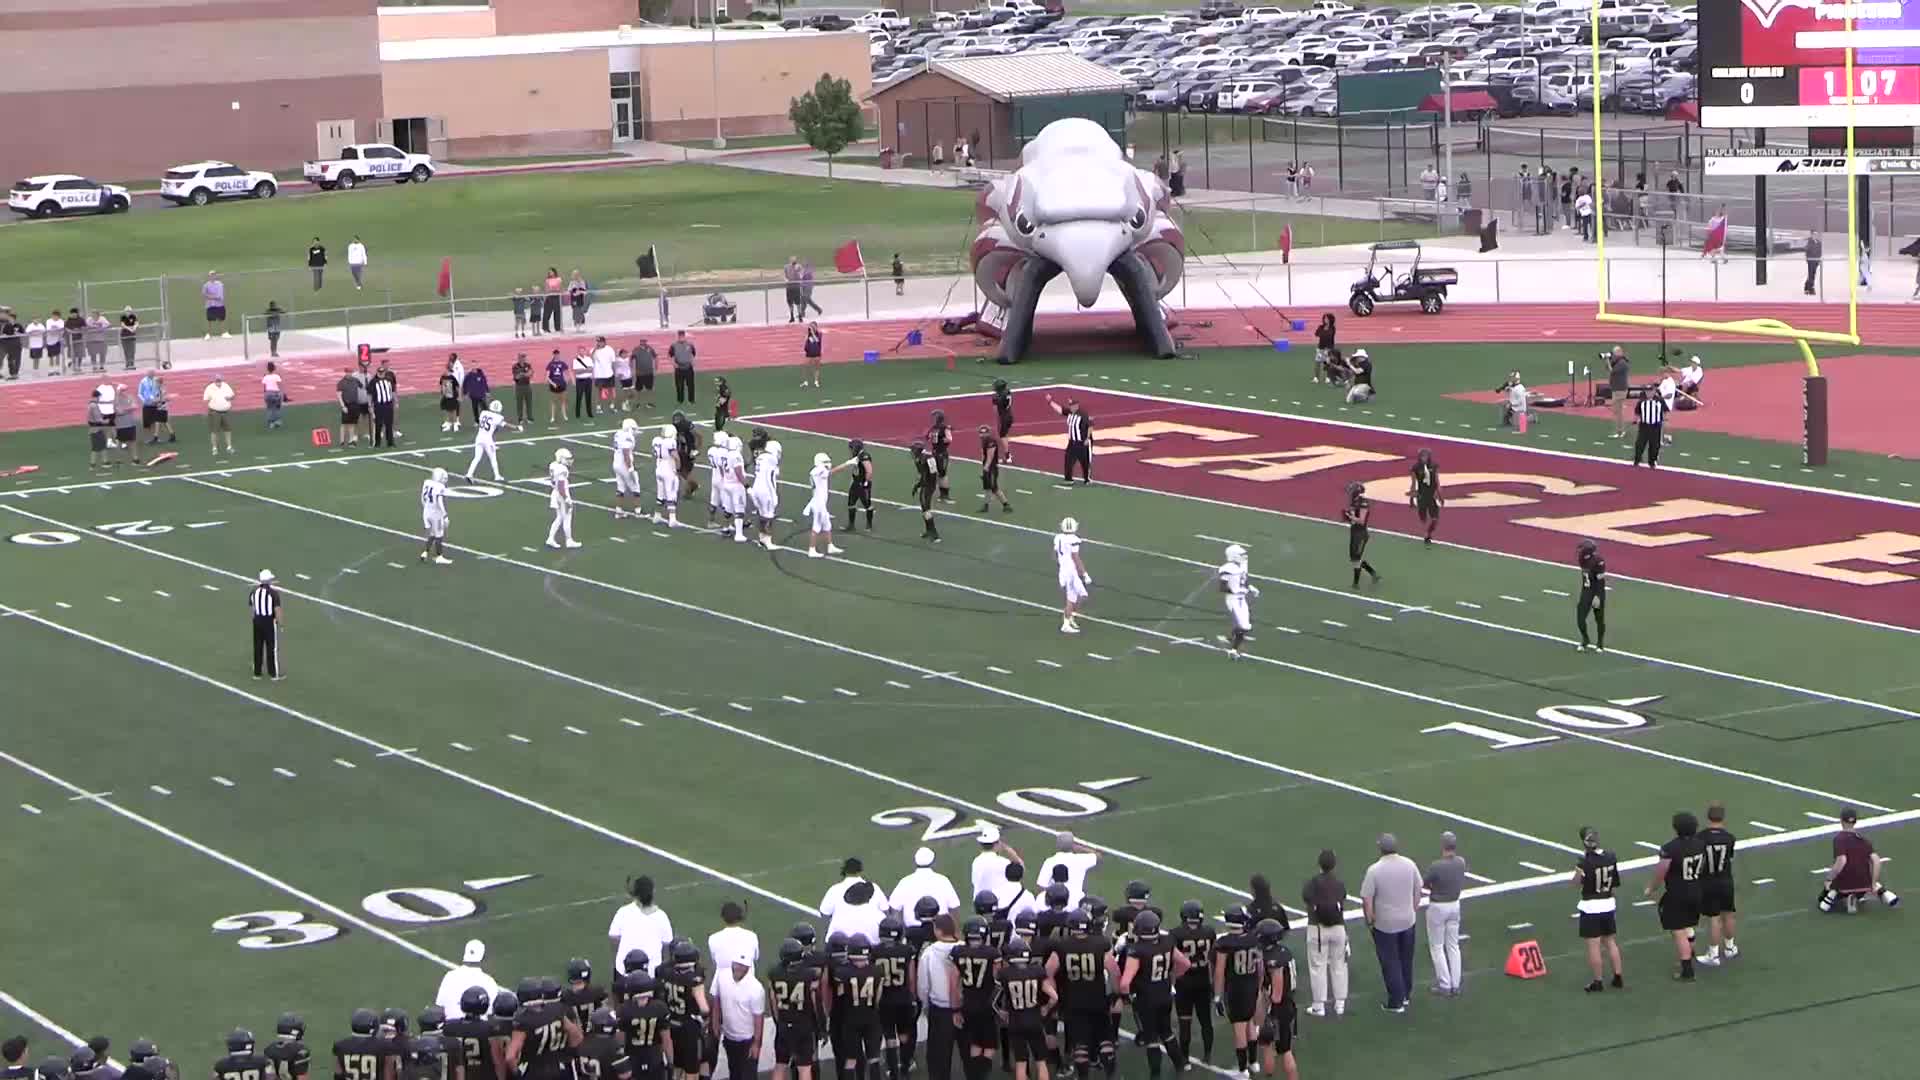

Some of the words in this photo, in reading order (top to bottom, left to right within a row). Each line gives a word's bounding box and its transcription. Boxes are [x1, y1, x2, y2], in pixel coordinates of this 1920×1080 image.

[1740, 82, 1754, 104] 0
[368, 162, 403, 173] POLICE
[61, 192, 98, 203] POLICE
[214, 179, 249, 190] POLICE
[360, 345, 369, 361] 2
[1419, 705, 1648, 750] 10
[1706, 844, 1727, 874] 17
[1595, 865, 1614, 893] 15
[211, 888, 477, 949] 30
[959, 958, 987, 988] 37
[1519, 946, 1544, 973] 20
[776, 981, 805, 1011] 24
[850, 976, 874, 1006] 14
[1008, 979, 1038, 1010] 80
[631, 1017, 658, 1046] 31
[344, 1055, 377, 1080] 59
